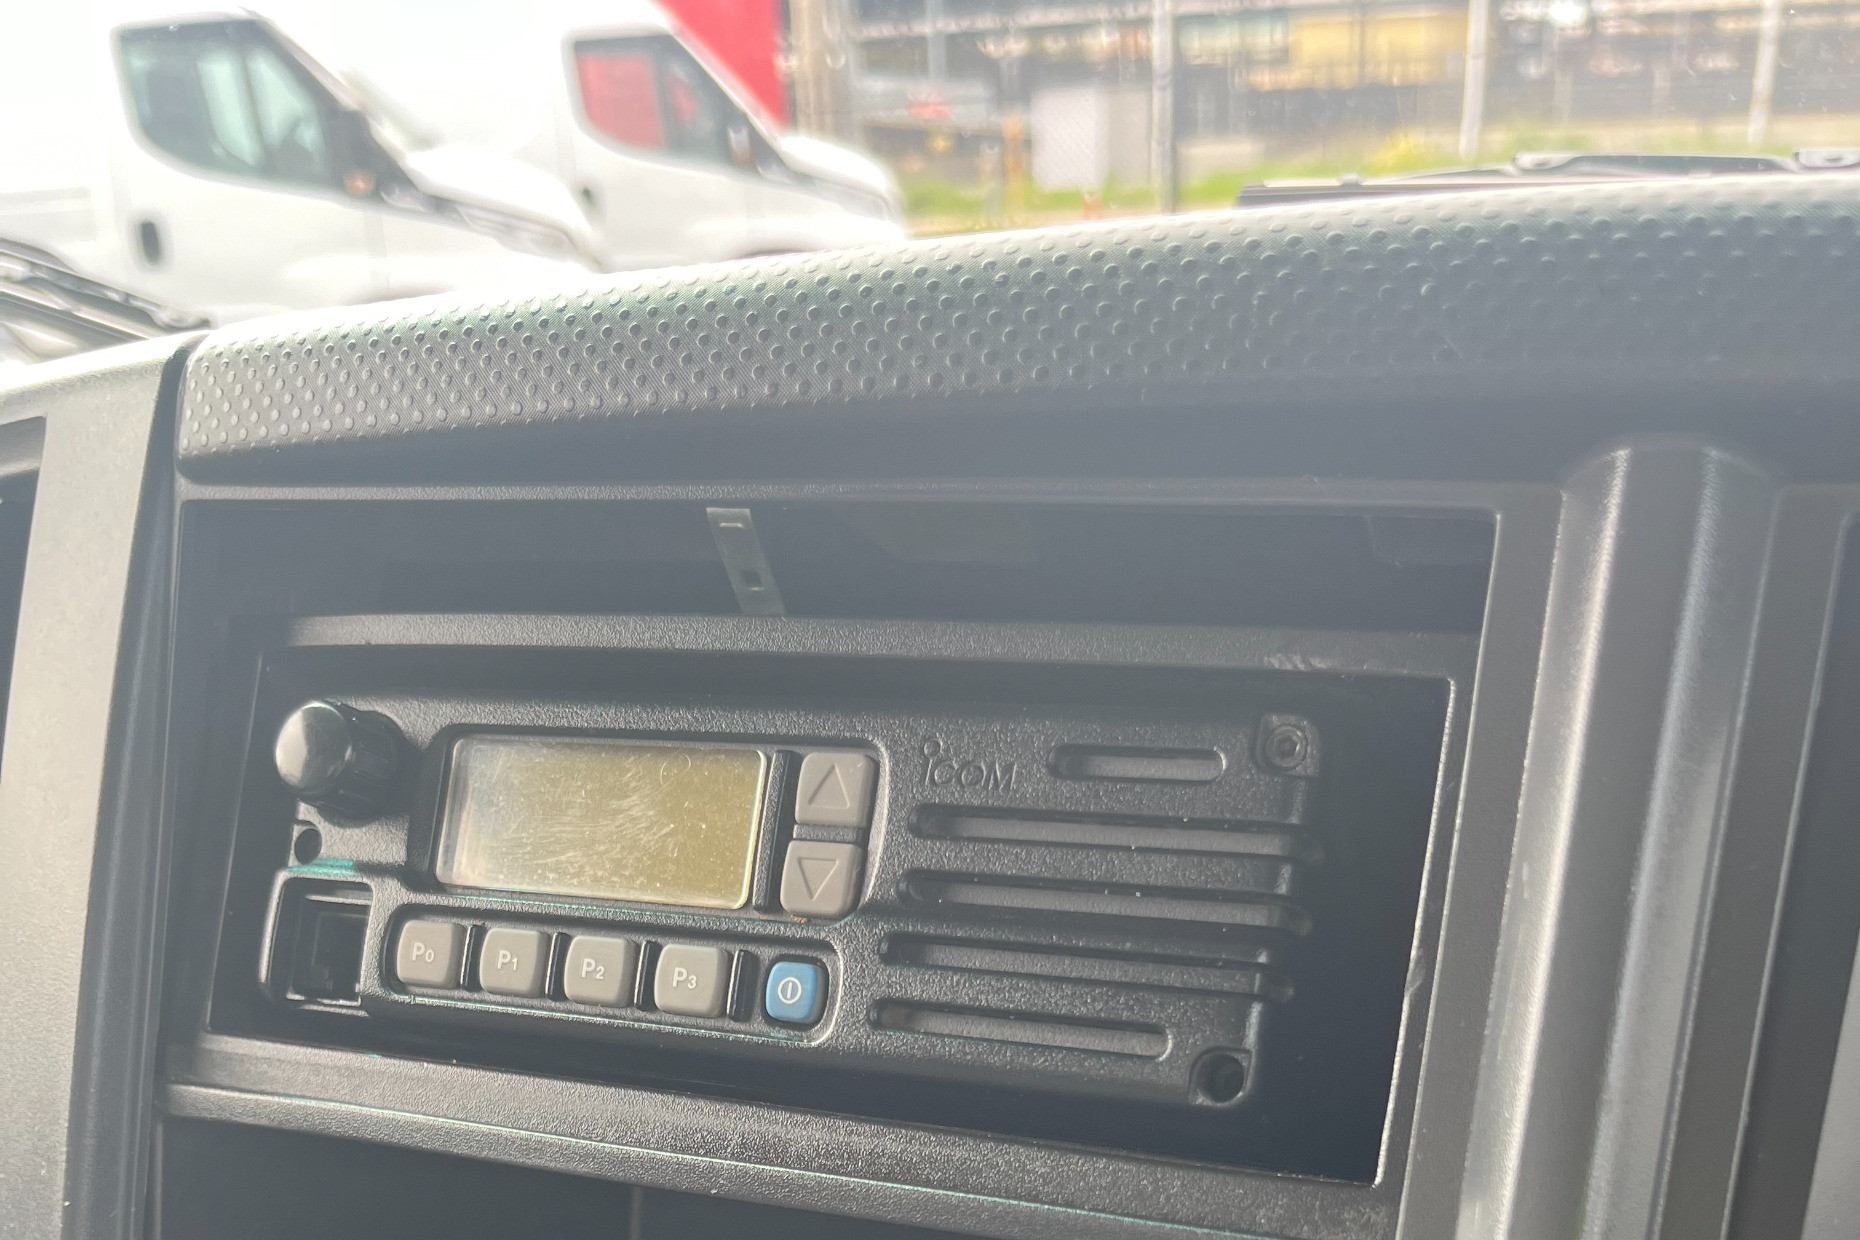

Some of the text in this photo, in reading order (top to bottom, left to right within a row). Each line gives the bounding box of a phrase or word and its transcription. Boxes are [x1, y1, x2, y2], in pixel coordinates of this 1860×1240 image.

[497, 950, 518, 971] P1
[581, 958, 605, 980] P2
[672, 967, 698, 989] P3
